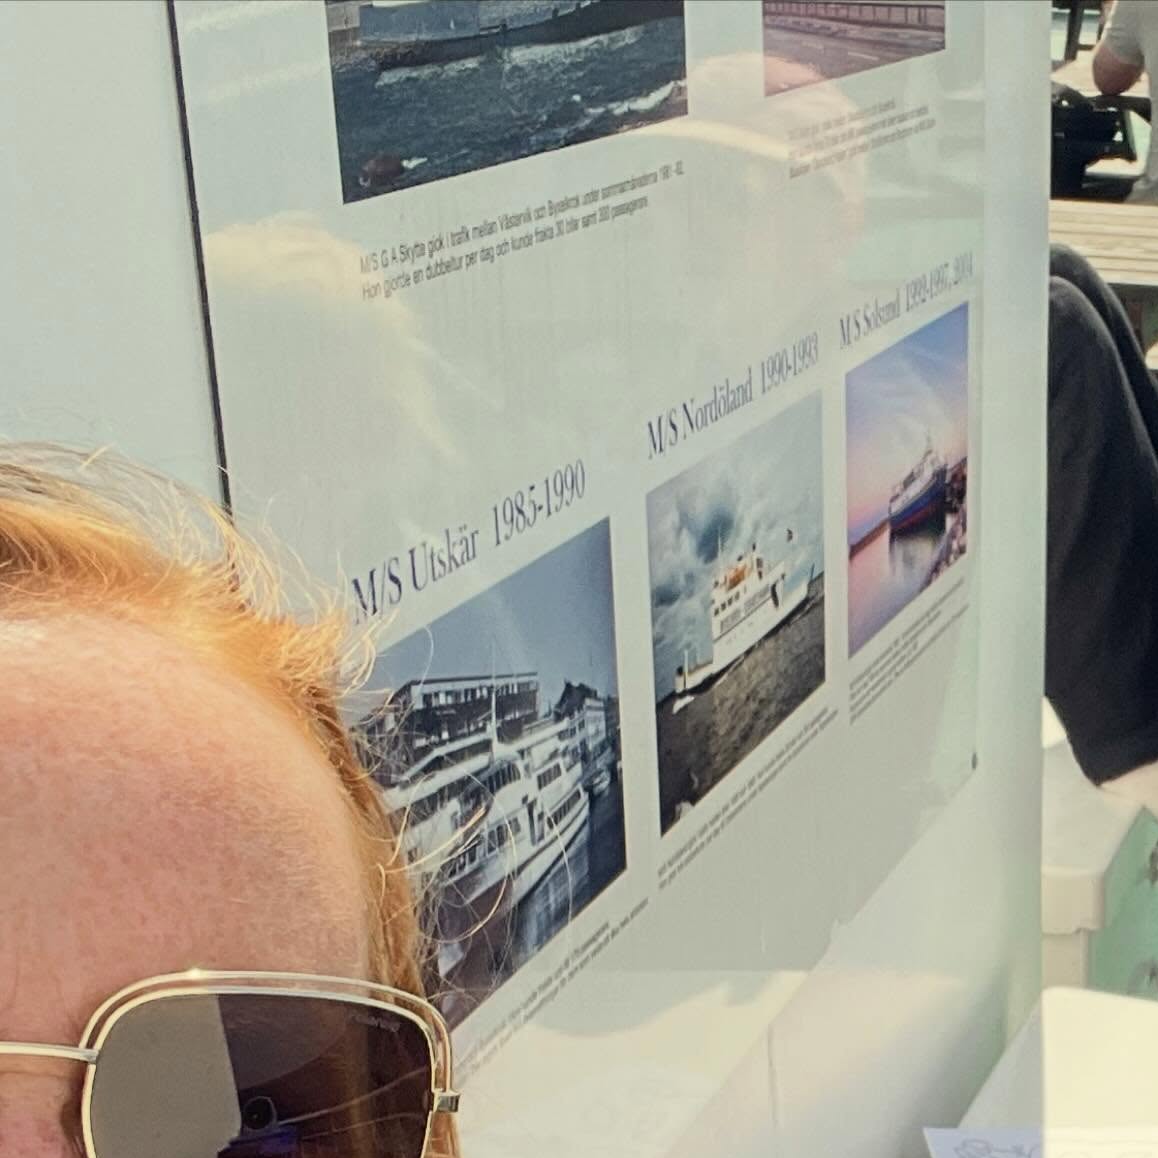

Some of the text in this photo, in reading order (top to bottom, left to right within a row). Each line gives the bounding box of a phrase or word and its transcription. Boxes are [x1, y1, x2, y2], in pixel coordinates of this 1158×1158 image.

[840, 308, 861, 351] M/S
[648, 330, 818, 461] M/S Nordöland 1990-1993
[352, 457, 586, 627] M/S Utskär 1985-1990
